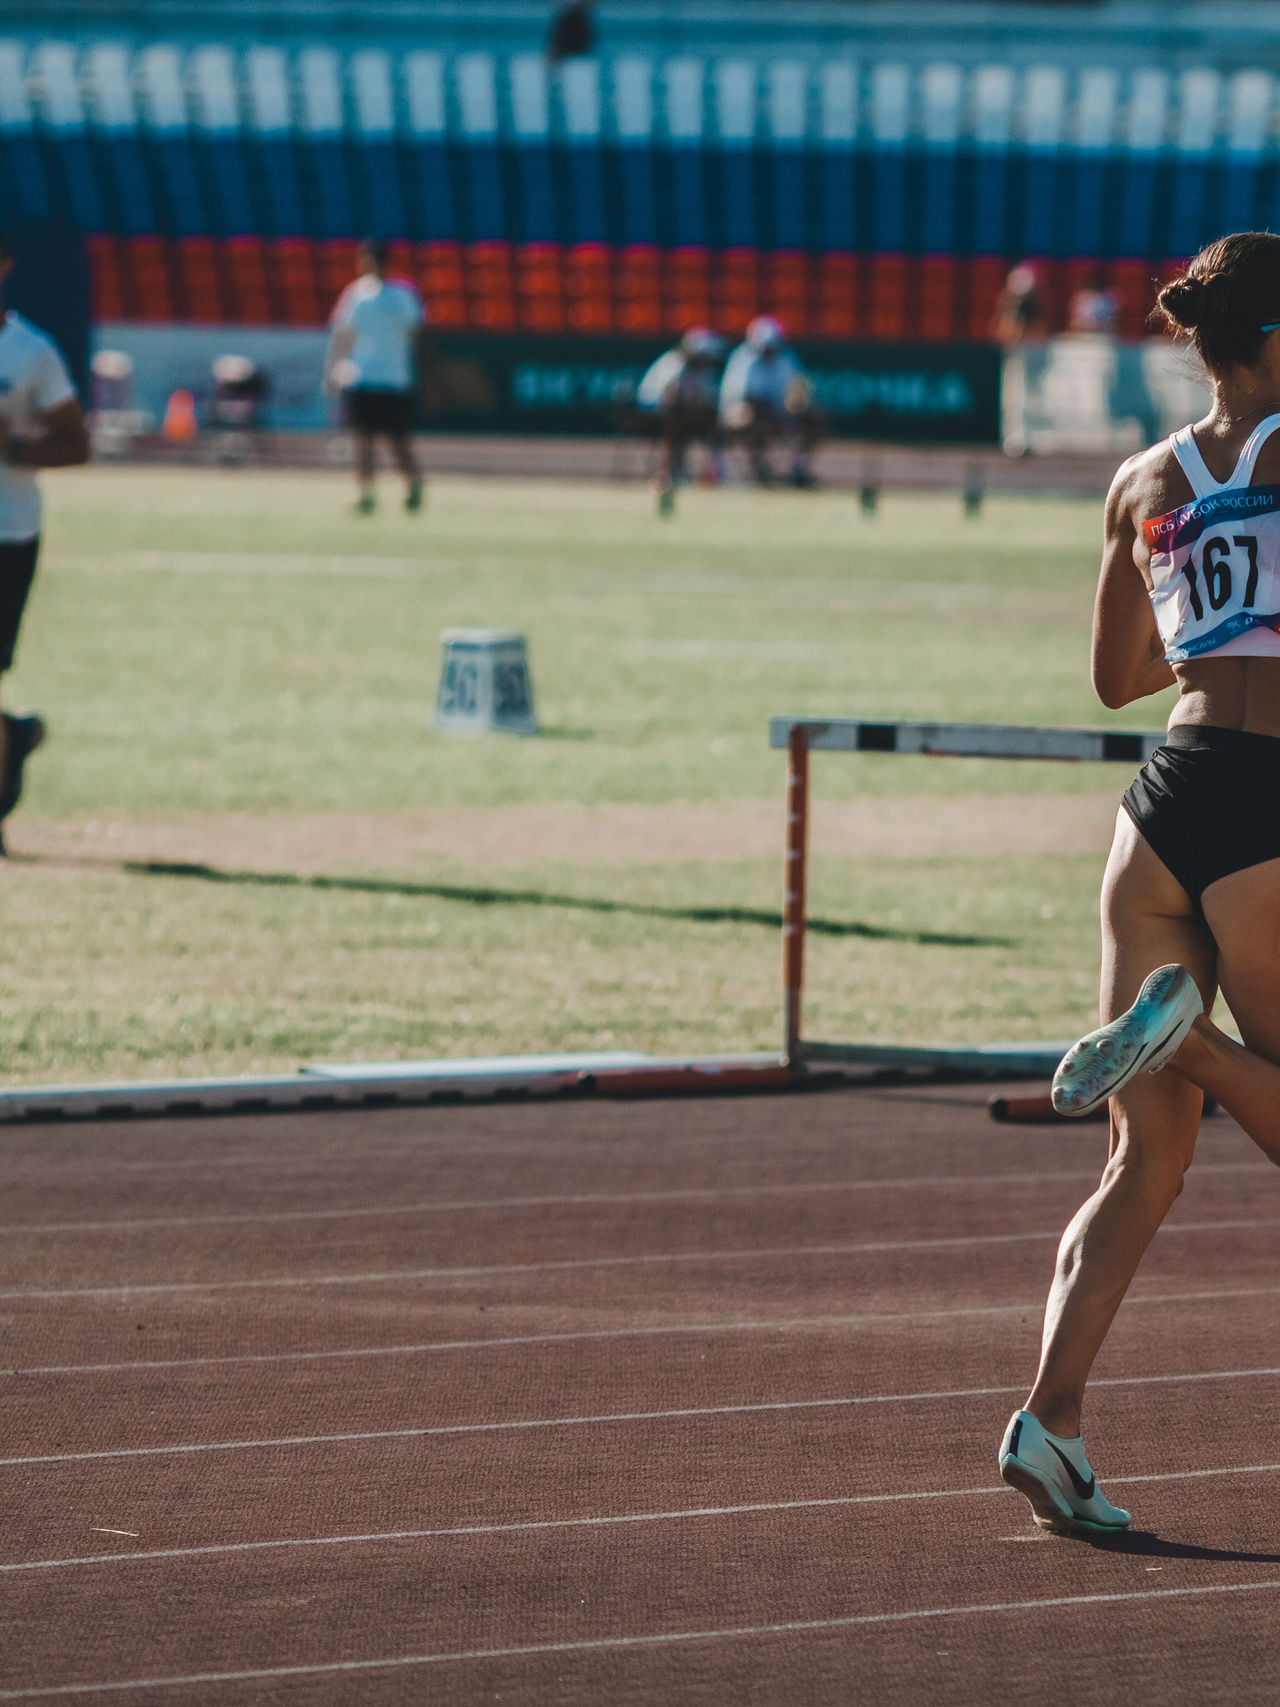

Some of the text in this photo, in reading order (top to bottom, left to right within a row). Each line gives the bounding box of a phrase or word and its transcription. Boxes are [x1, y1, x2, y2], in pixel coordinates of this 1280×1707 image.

[1150, 519, 1175, 537] ПСБ
[1220, 494, 1274, 509] РОССИИ
[1181, 535, 1258, 621] 167
